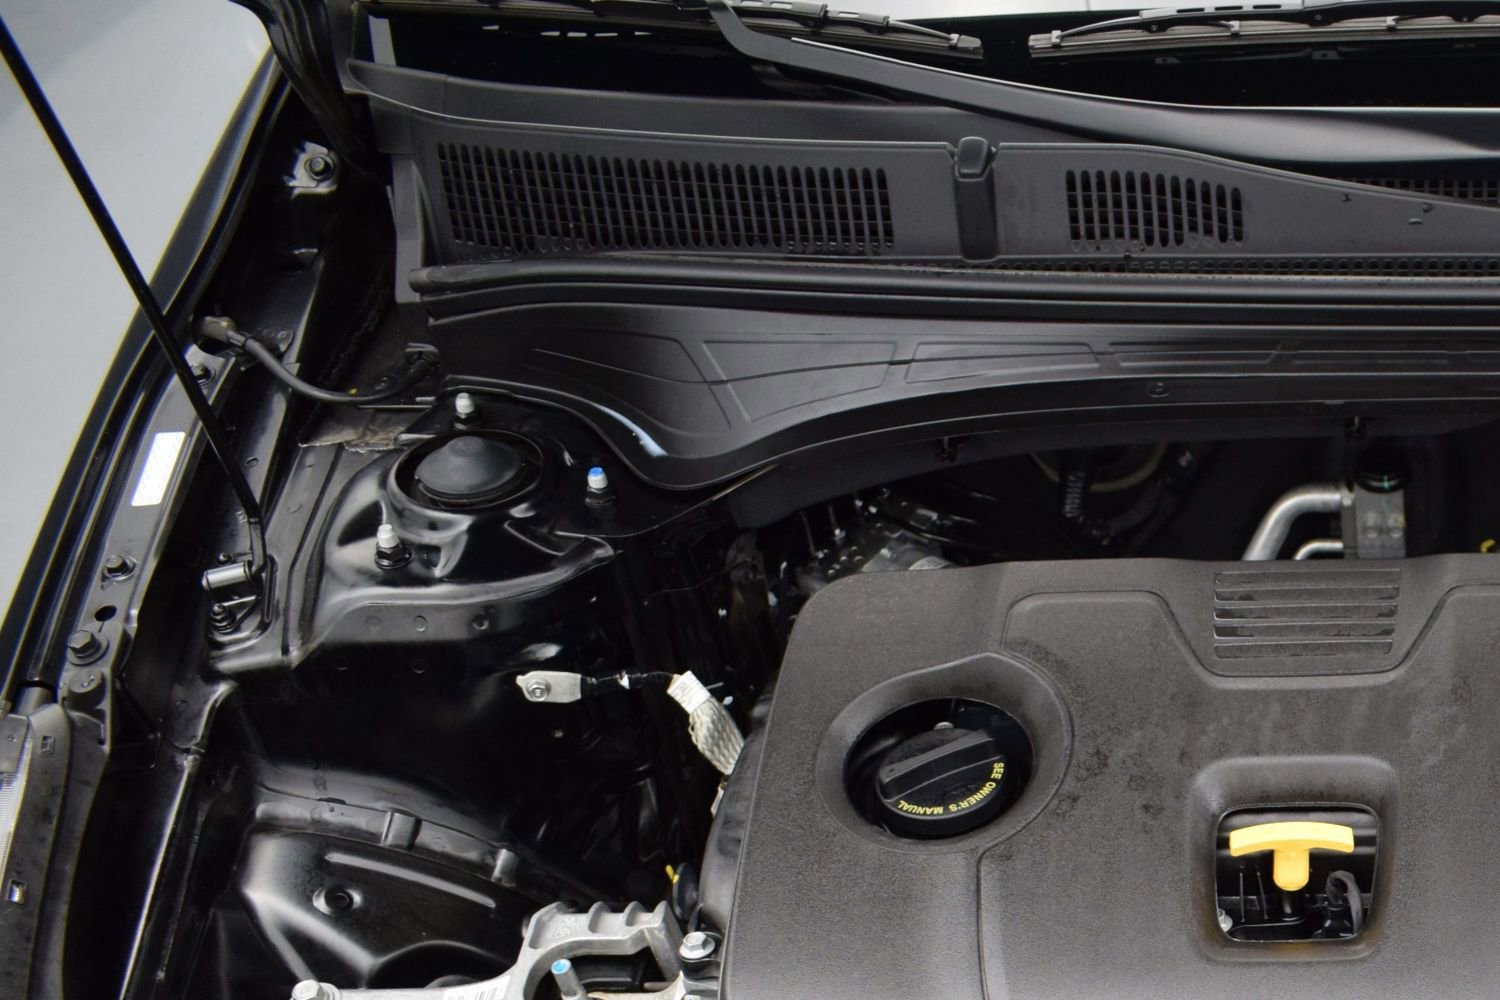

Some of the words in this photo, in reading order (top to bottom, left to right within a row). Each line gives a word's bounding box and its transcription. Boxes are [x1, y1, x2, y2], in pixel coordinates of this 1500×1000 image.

[993, 762, 1005, 780] SEE
[949, 781, 997, 812] OWNER'S
[898, 800, 944, 815] MANUAL
